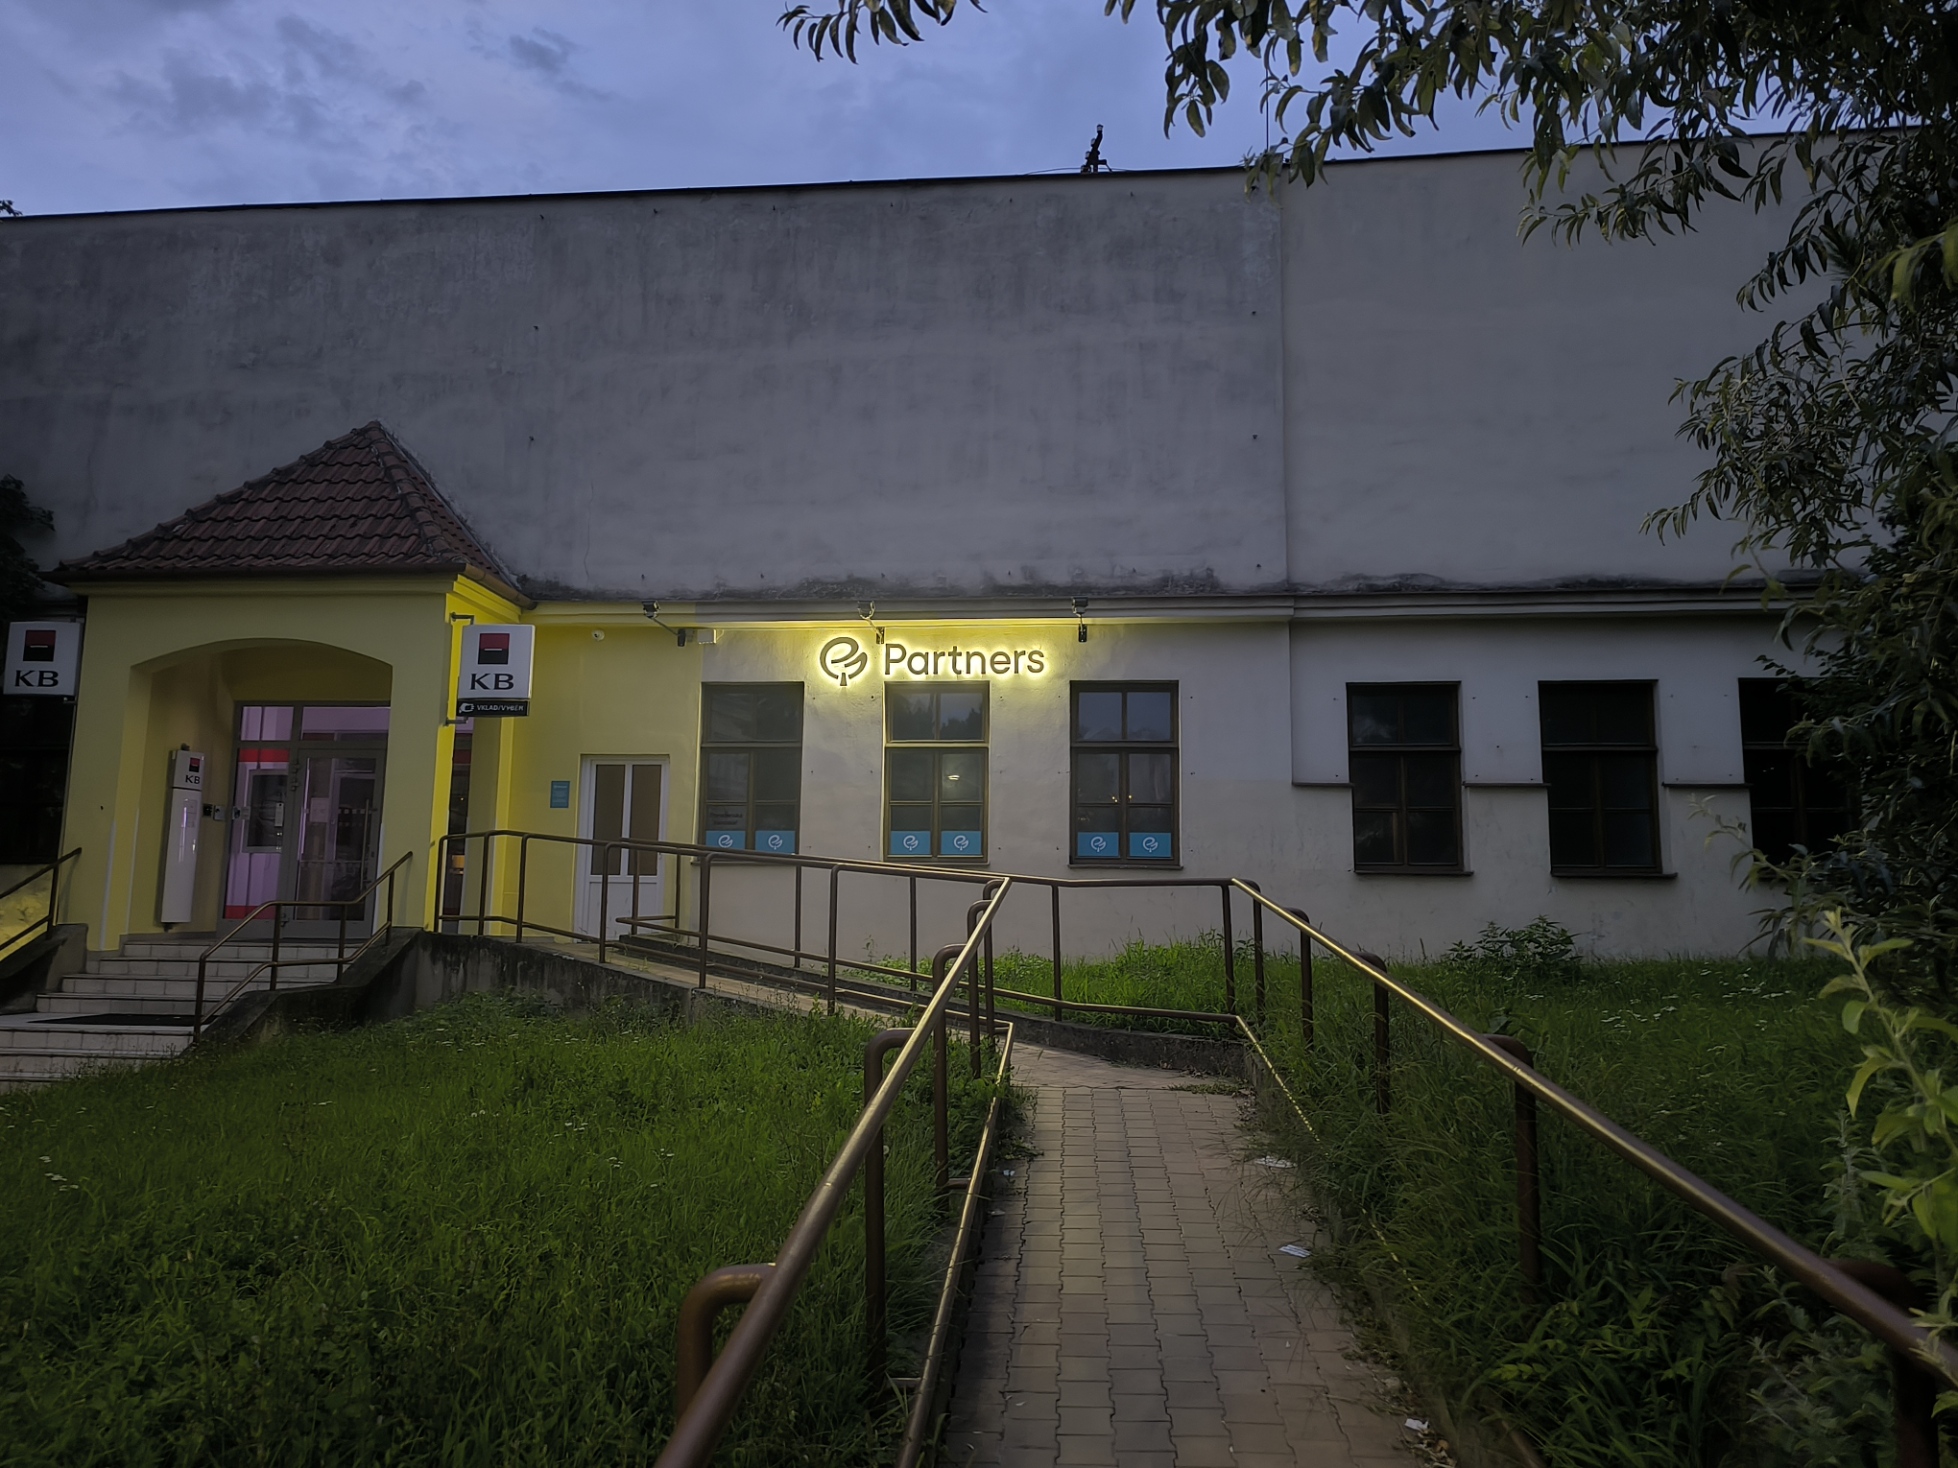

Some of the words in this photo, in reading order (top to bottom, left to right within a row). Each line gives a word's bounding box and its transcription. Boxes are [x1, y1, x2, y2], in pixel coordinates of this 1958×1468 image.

[885, 643, 1045, 675] Partners
[14, 670, 59, 687] KB
[470, 673, 514, 690] KB
[185, 775, 201, 785] KB
